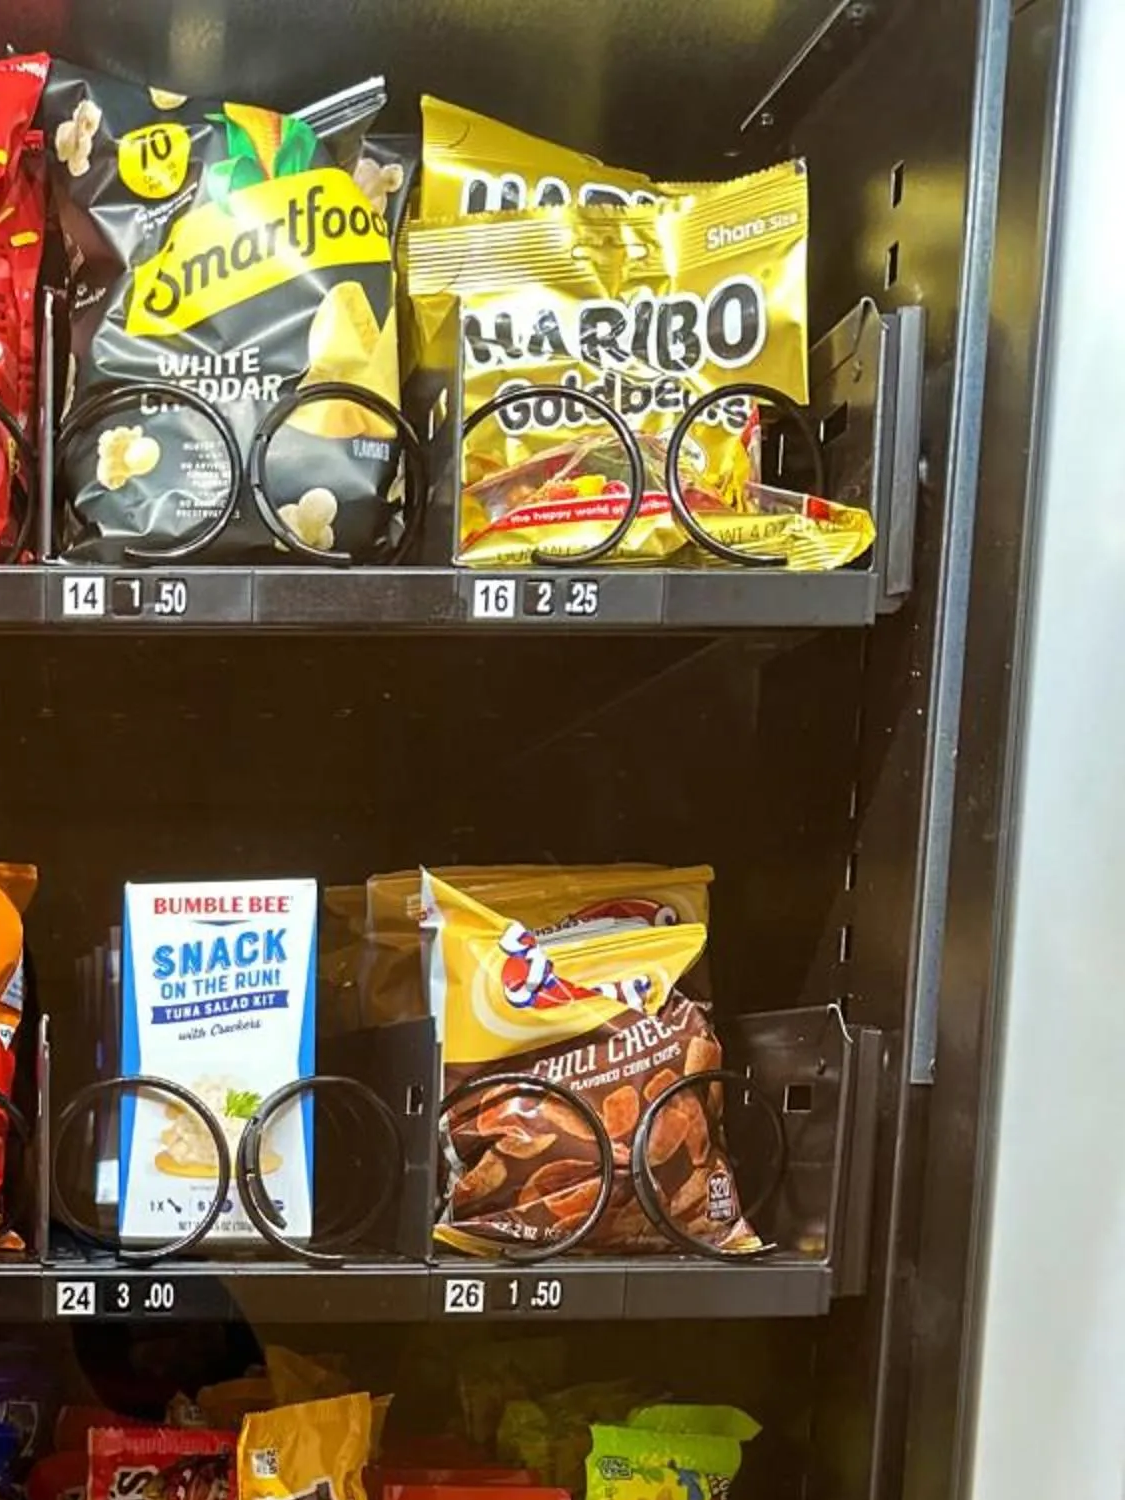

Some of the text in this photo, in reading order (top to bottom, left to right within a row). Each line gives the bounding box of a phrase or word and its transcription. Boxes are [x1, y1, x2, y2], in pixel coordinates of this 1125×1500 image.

[133, 129, 172, 170] 70
[705, 219, 765, 252] Share
[463, 282, 765, 372] HARIBO
[157, 347, 261, 377] WHITE
[69, 582, 98, 609] 14
[480, 585, 508, 613] 16
[154, 896, 291, 915] BUMBLE BEE
[151, 928, 288, 980] SNACK
[160, 968, 281, 1000] ON THE RUN!
[165, 993, 276, 1021] TUNA SALAD KIT
[178, 1018, 262, 1041] with Crackers
[533, 1043, 597, 1083] CHILI
[62, 1286, 91, 1311] 24
[450, 1282, 480, 1308] 26
